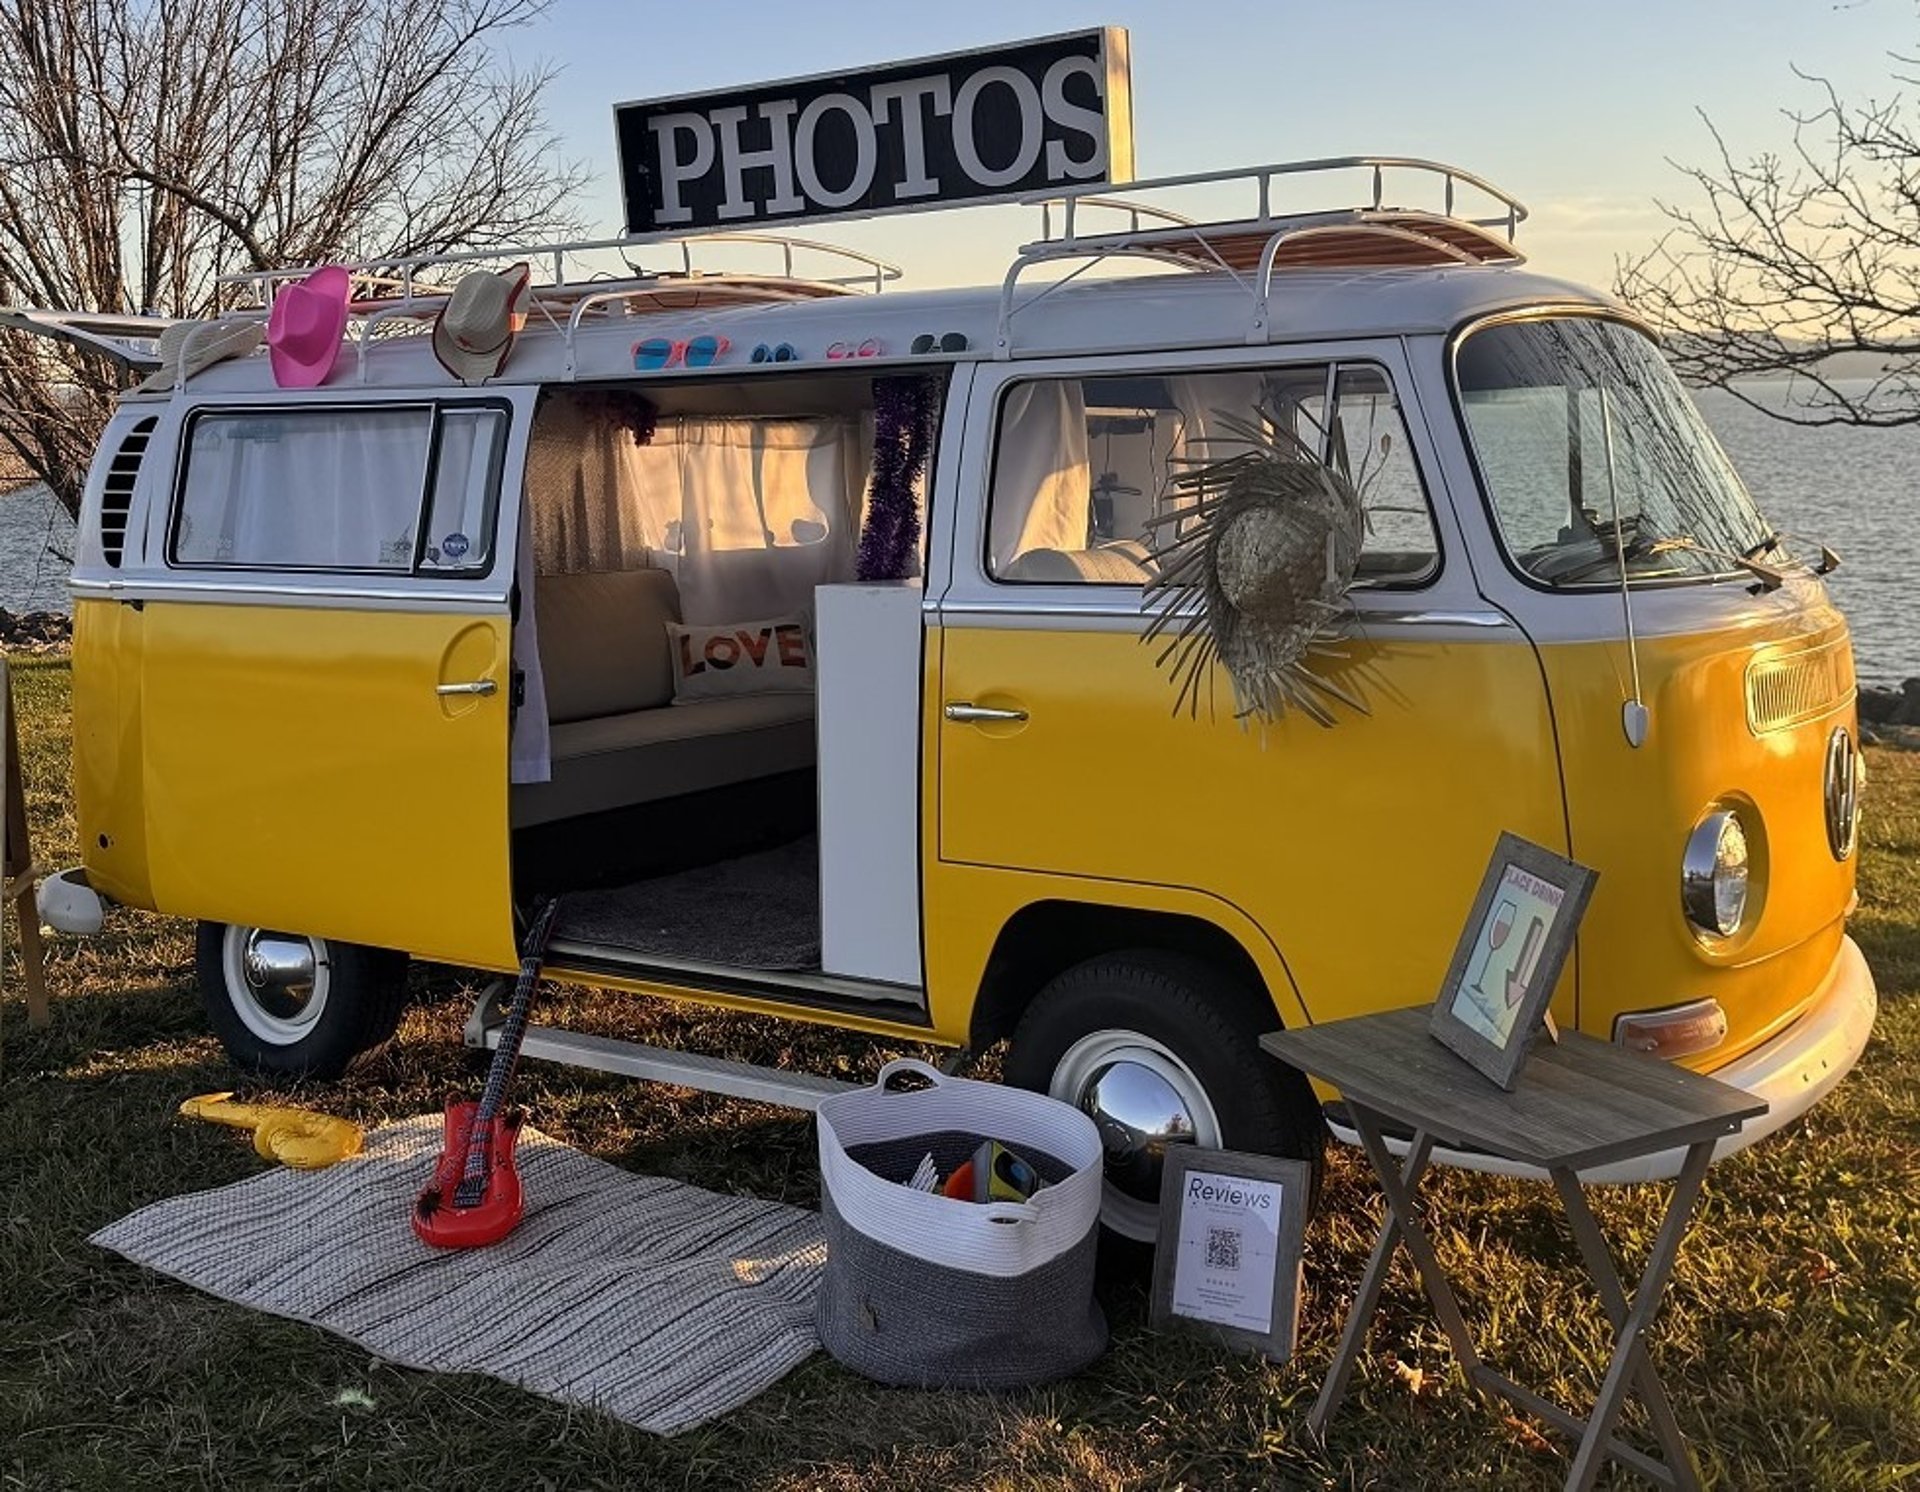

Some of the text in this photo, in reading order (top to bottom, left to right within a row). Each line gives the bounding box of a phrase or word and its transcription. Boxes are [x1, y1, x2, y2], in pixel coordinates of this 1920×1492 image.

[648, 54, 1106, 224] PHOTOS
[680, 624, 807, 679] LOVE
[1189, 1178, 1271, 1209] Reviews
